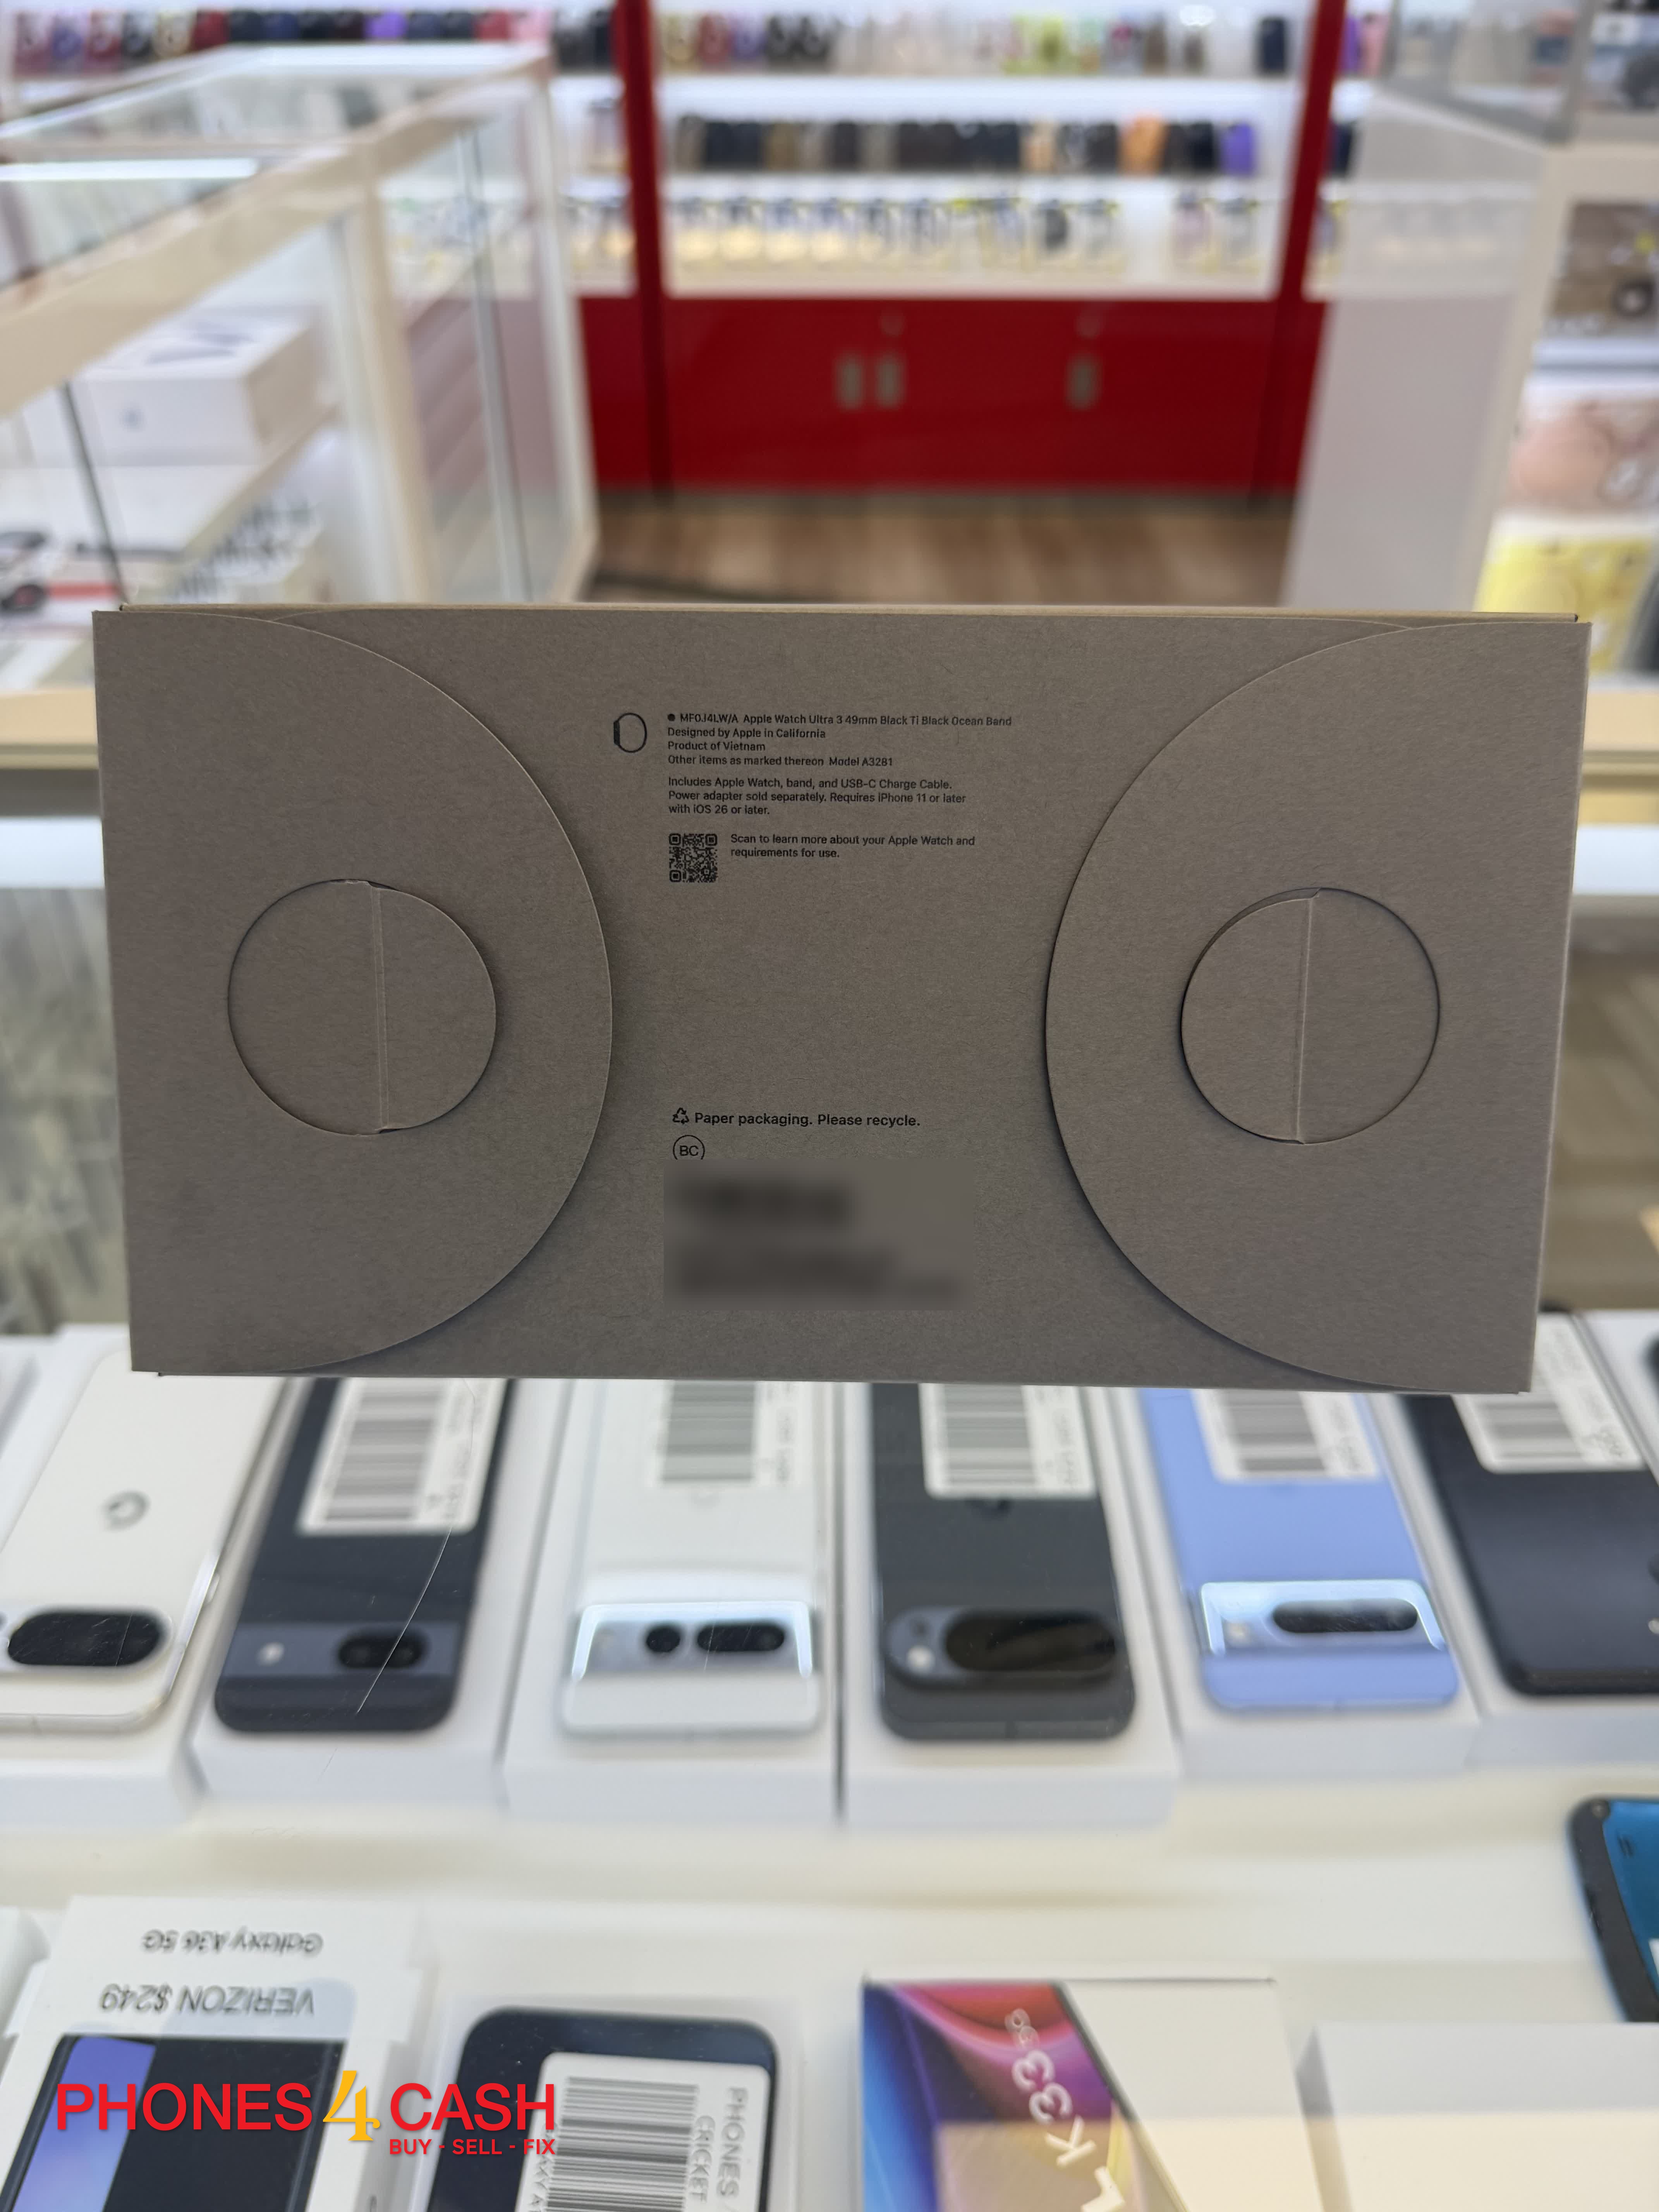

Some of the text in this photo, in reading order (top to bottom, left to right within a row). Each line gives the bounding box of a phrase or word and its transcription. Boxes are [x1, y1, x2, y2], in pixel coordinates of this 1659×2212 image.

[743, 714, 772, 725] Apple
[774, 714, 806, 724] Watch
[809, 714, 833, 724] Ultra
[836, 715, 843, 724] 3
[845, 715, 878, 725] 49mm
[880, 715, 908, 725] Black
[909, 715, 919, 725] Ti
[921, 715, 949, 725] Black
[951, 716, 983, 726] Ocean
[986, 716, 1012, 726] Band
[668, 727, 826, 739] Designed by Apple in California
[668, 741, 766, 751] Product of Vietnam
[668, 754, 696, 764] Other
[699, 754, 728, 765] items
[744, 756, 782, 766] marked
[784, 756, 824, 766] thereon
[829, 756, 859, 766] Model
[862, 757, 892, 766] A3281
[668, 776, 952, 791] Includes Apple Watch, band, and USB-C Charge Cable.
[668, 790, 701, 800] Power
[703, 790, 743, 802] adapter
[745, 791, 768, 801] sold
[771, 792, 827, 804] separately.
[830, 792, 875, 804] Requires
[878, 792, 913, 802] iPhone
[916, 793, 926, 802] 11
[943, 793, 966, 803] later
[668, 804, 690, 814] with
[693, 804, 711, 814] iOS
[714, 804, 728, 814] 26
[744, 805, 770, 815] later.
[731, 833, 975, 847] Scan to learn more about your Apple Watch and
[731, 847, 798, 859] requirements
[800, 848, 816, 857] for
[695, 1112, 921, 1128] Paper packaging. Please recycle.
[680, 1145, 699, 1156] BC
[100, 1982, 315, 2015] VERIZON $249
[689, 2115, 716, 2202] CRICKET
